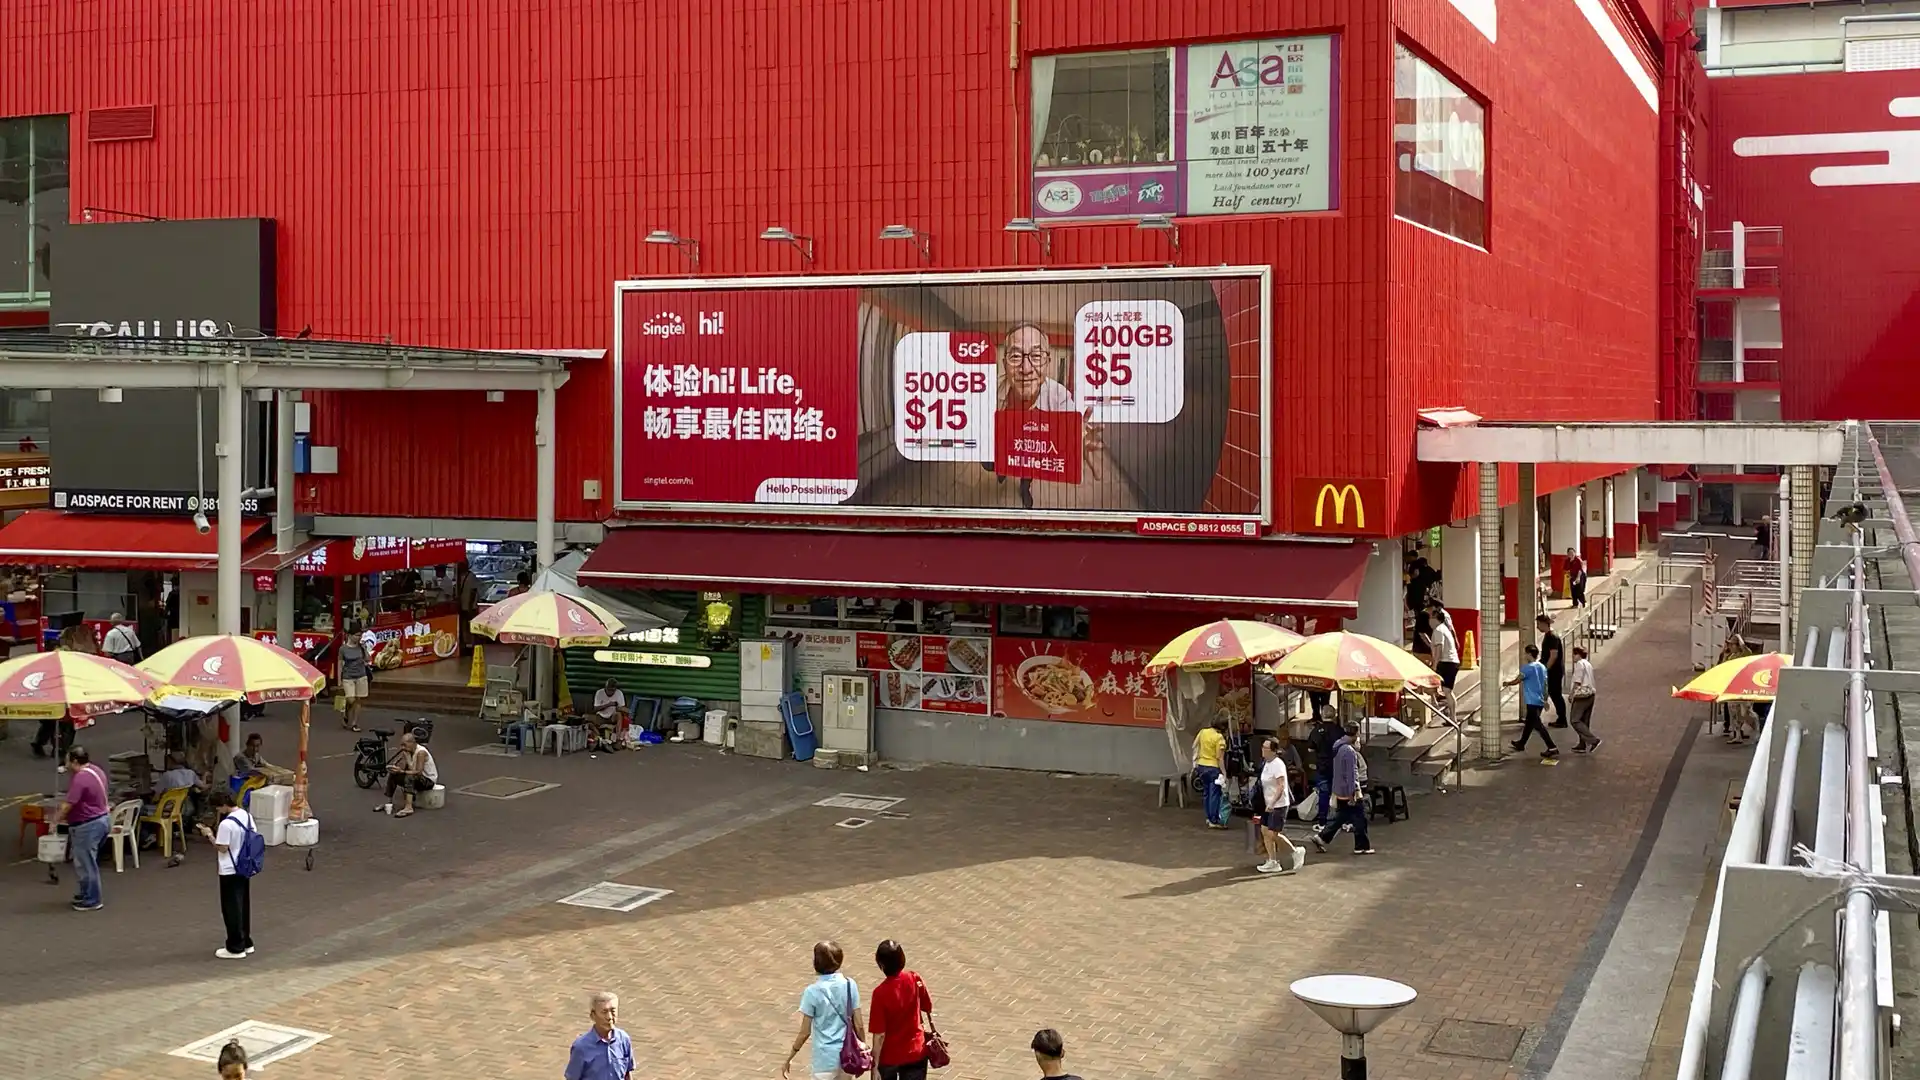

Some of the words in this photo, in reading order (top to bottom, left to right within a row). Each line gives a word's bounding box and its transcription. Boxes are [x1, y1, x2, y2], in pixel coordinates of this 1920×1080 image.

[1210, 50, 1284, 88] Asa
[1234, 125, 1265, 140] 百年
[1262, 138, 1309, 154] 五十年
[1246, 167, 1269, 178] 100
[1270, 164, 1310, 180] years!
[1212, 195, 1245, 211] Half
[1250, 193, 1302, 208] century!
[643, 321, 685, 339] Singtel
[699, 311, 724, 335] hi!
[1084, 325, 1173, 347] 400GB
[1085, 349, 1132, 389] $5
[741, 367, 803, 404] Life,
[904, 371, 987, 393] 500GB
[905, 395, 968, 433] $15
[643, 405, 837, 442] 畅享最佳网络。
[1013, 438, 1058, 455] 欢迎加入
[17, 466, 50, 476] FRESH
[766, 484, 790, 494] Hello
[791, 484, 848, 496] Possibilities
[70, 494, 124, 508] ADSPACE
[126, 495, 151, 509] FOR
[152, 496, 184, 510] RENT
[202, 497, 220, 510] 881
[1142, 522, 1186, 532] ADSPACE
[1198, 523, 1219, 533] 8812
[1220, 524, 1241, 533] 0555
